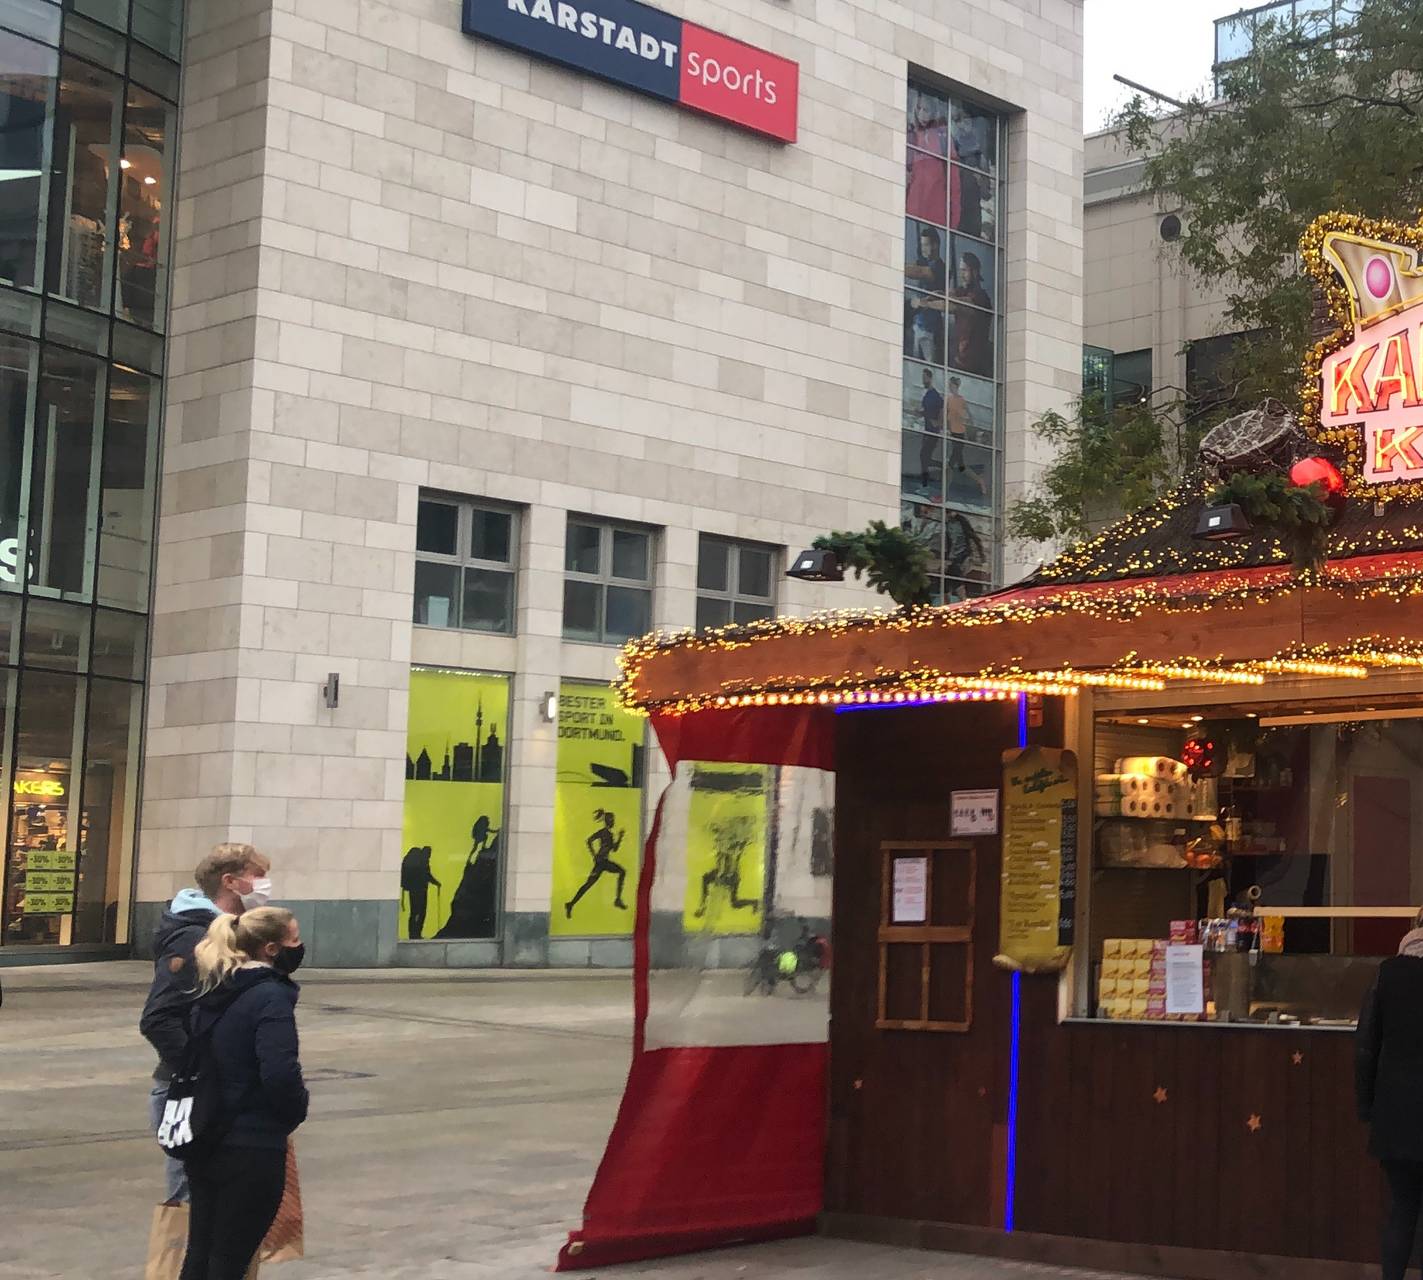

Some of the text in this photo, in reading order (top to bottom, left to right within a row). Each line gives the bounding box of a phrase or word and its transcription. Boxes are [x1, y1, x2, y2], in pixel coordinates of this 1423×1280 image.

[508, 0, 777, 105] KARSTADT sports
[558, 694, 605, 709] BESTER
[558, 711, 597, 724] SPORT
